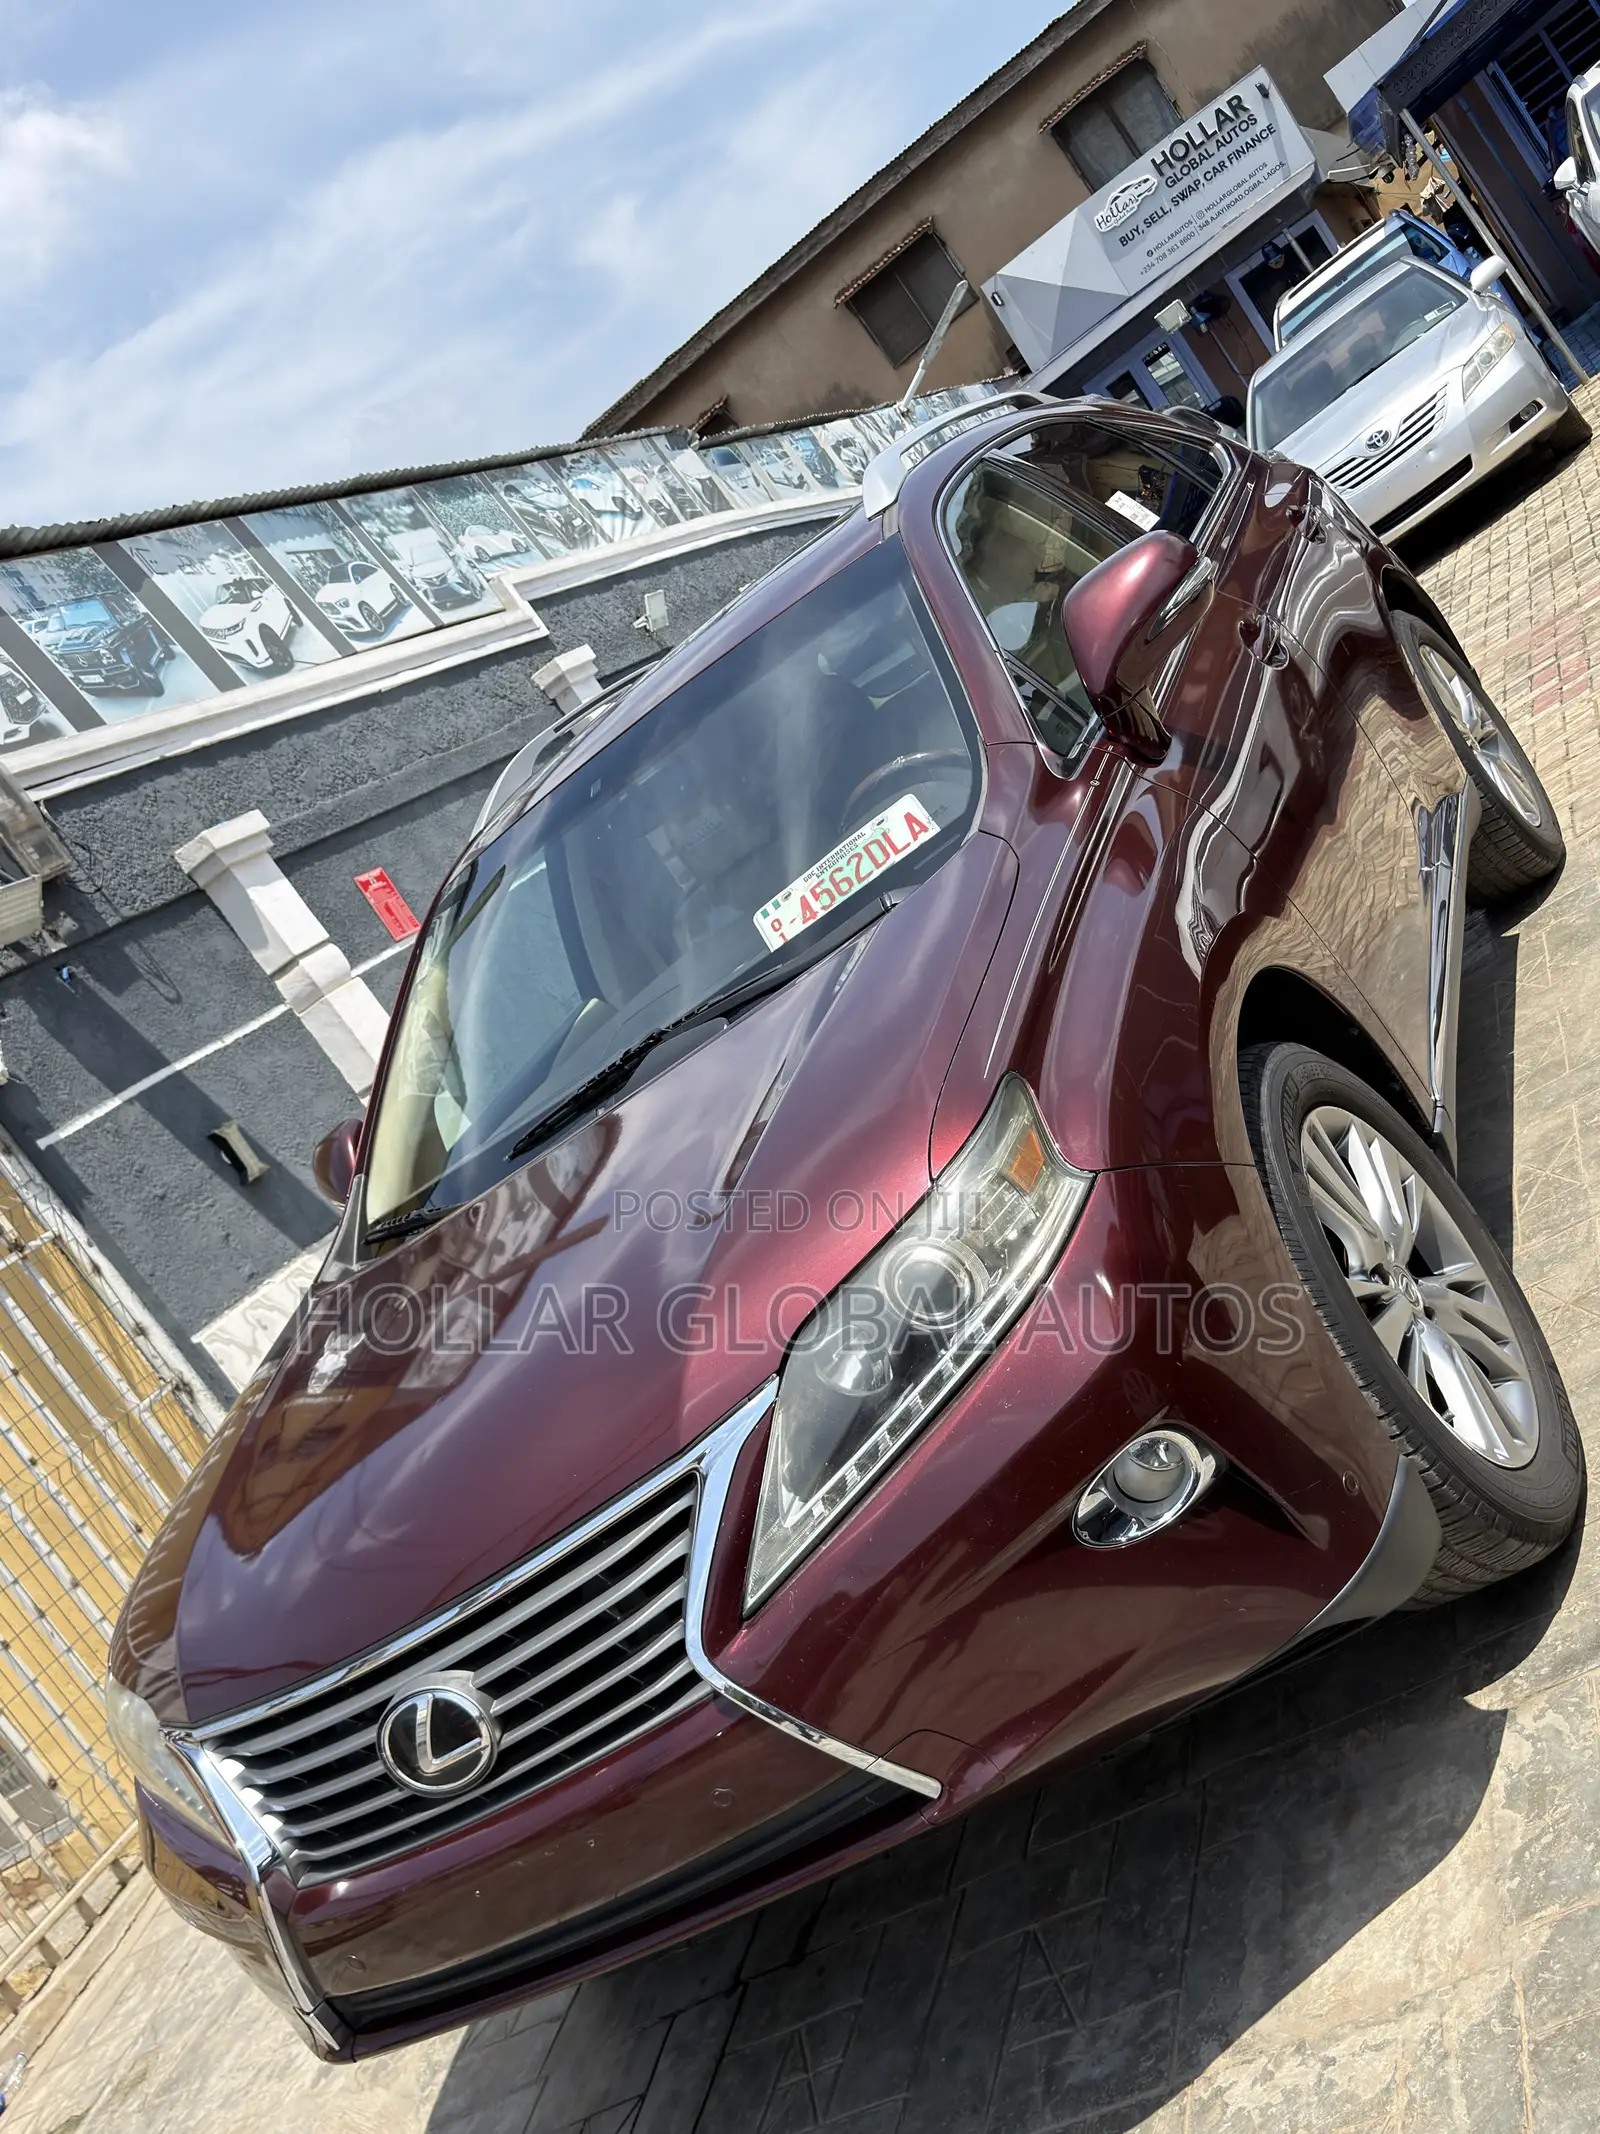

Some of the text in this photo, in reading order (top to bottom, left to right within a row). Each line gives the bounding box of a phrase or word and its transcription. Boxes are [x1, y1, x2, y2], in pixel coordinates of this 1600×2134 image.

[1151, 95, 1250, 176] HOLLAR
[1165, 114, 1257, 188] GLOBAL AUTOS
[1119, 123, 1276, 247] BUY, SELL, SWAP, CAR FINANCE
[1152, 219, 1193, 252] HOLLARAUTOS
[815, 831, 867, 872] INTERNATIONAL
